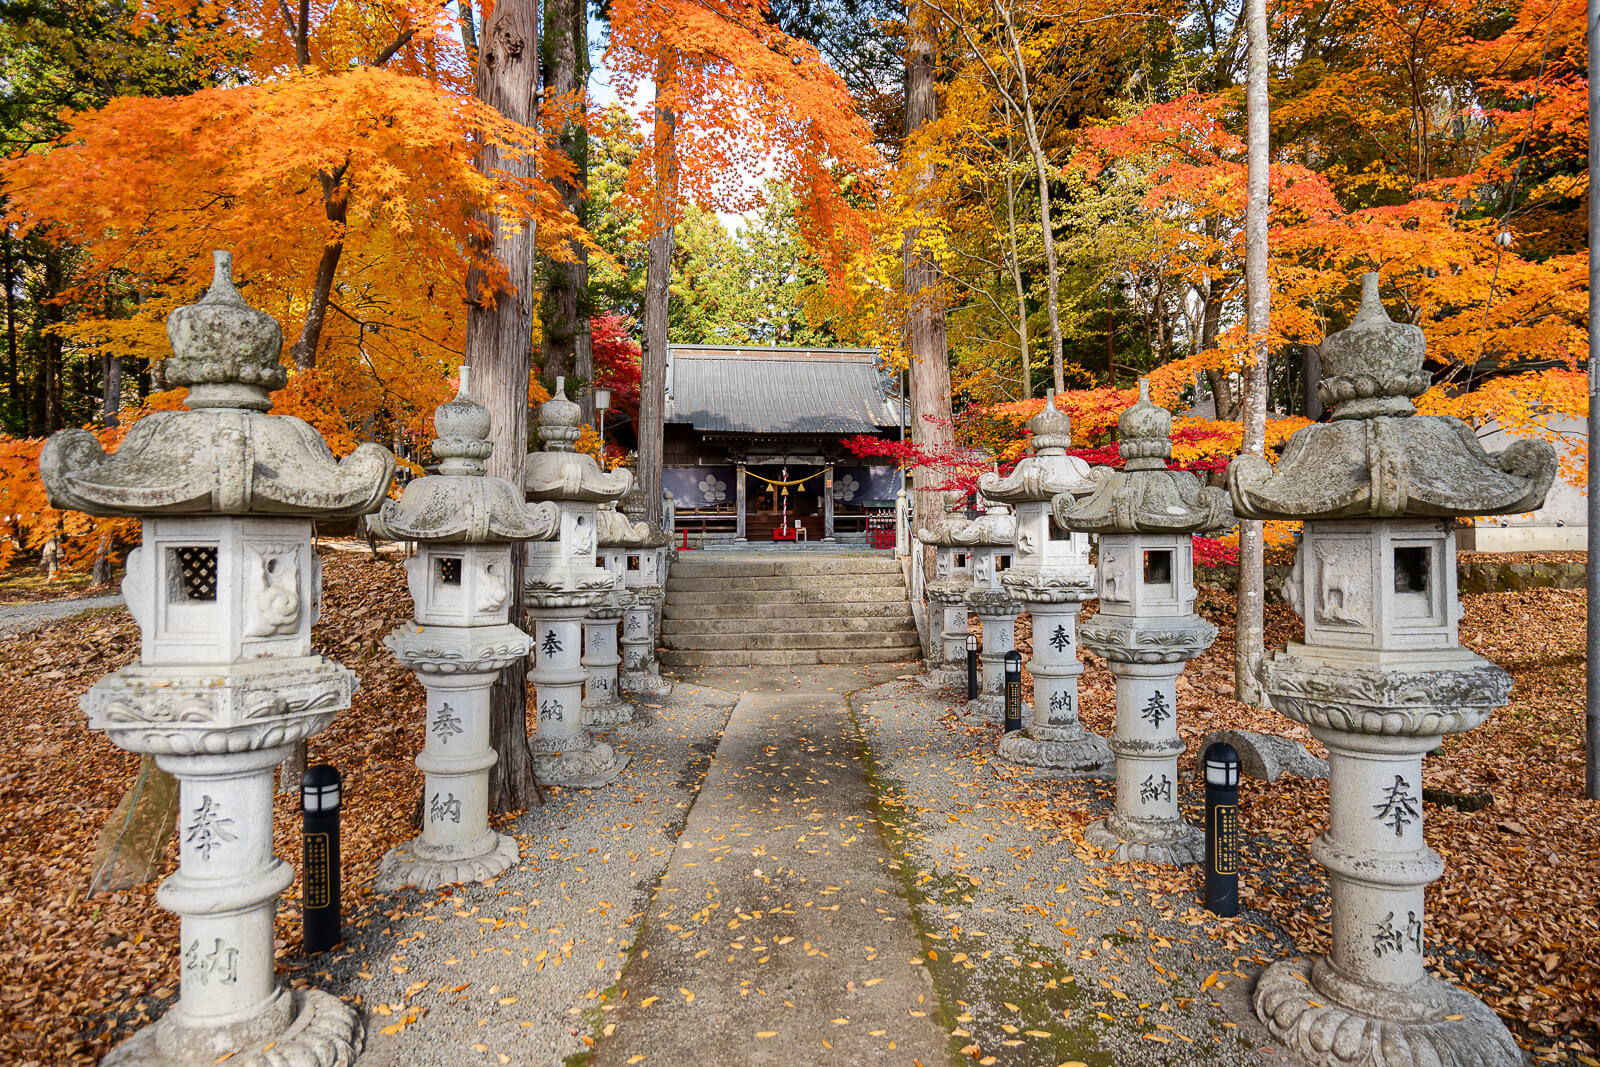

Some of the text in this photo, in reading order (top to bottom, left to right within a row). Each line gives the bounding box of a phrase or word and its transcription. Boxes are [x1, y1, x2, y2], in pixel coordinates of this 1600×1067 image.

[540, 630, 564, 723] 奉納
[1049, 624, 1072, 713] 奉納
[430, 702, 463, 824] 奉納
[1140, 690, 1171, 804] 奉納
[185, 795, 239, 987] 奉納
[1373, 774, 1421, 958] 奉納
